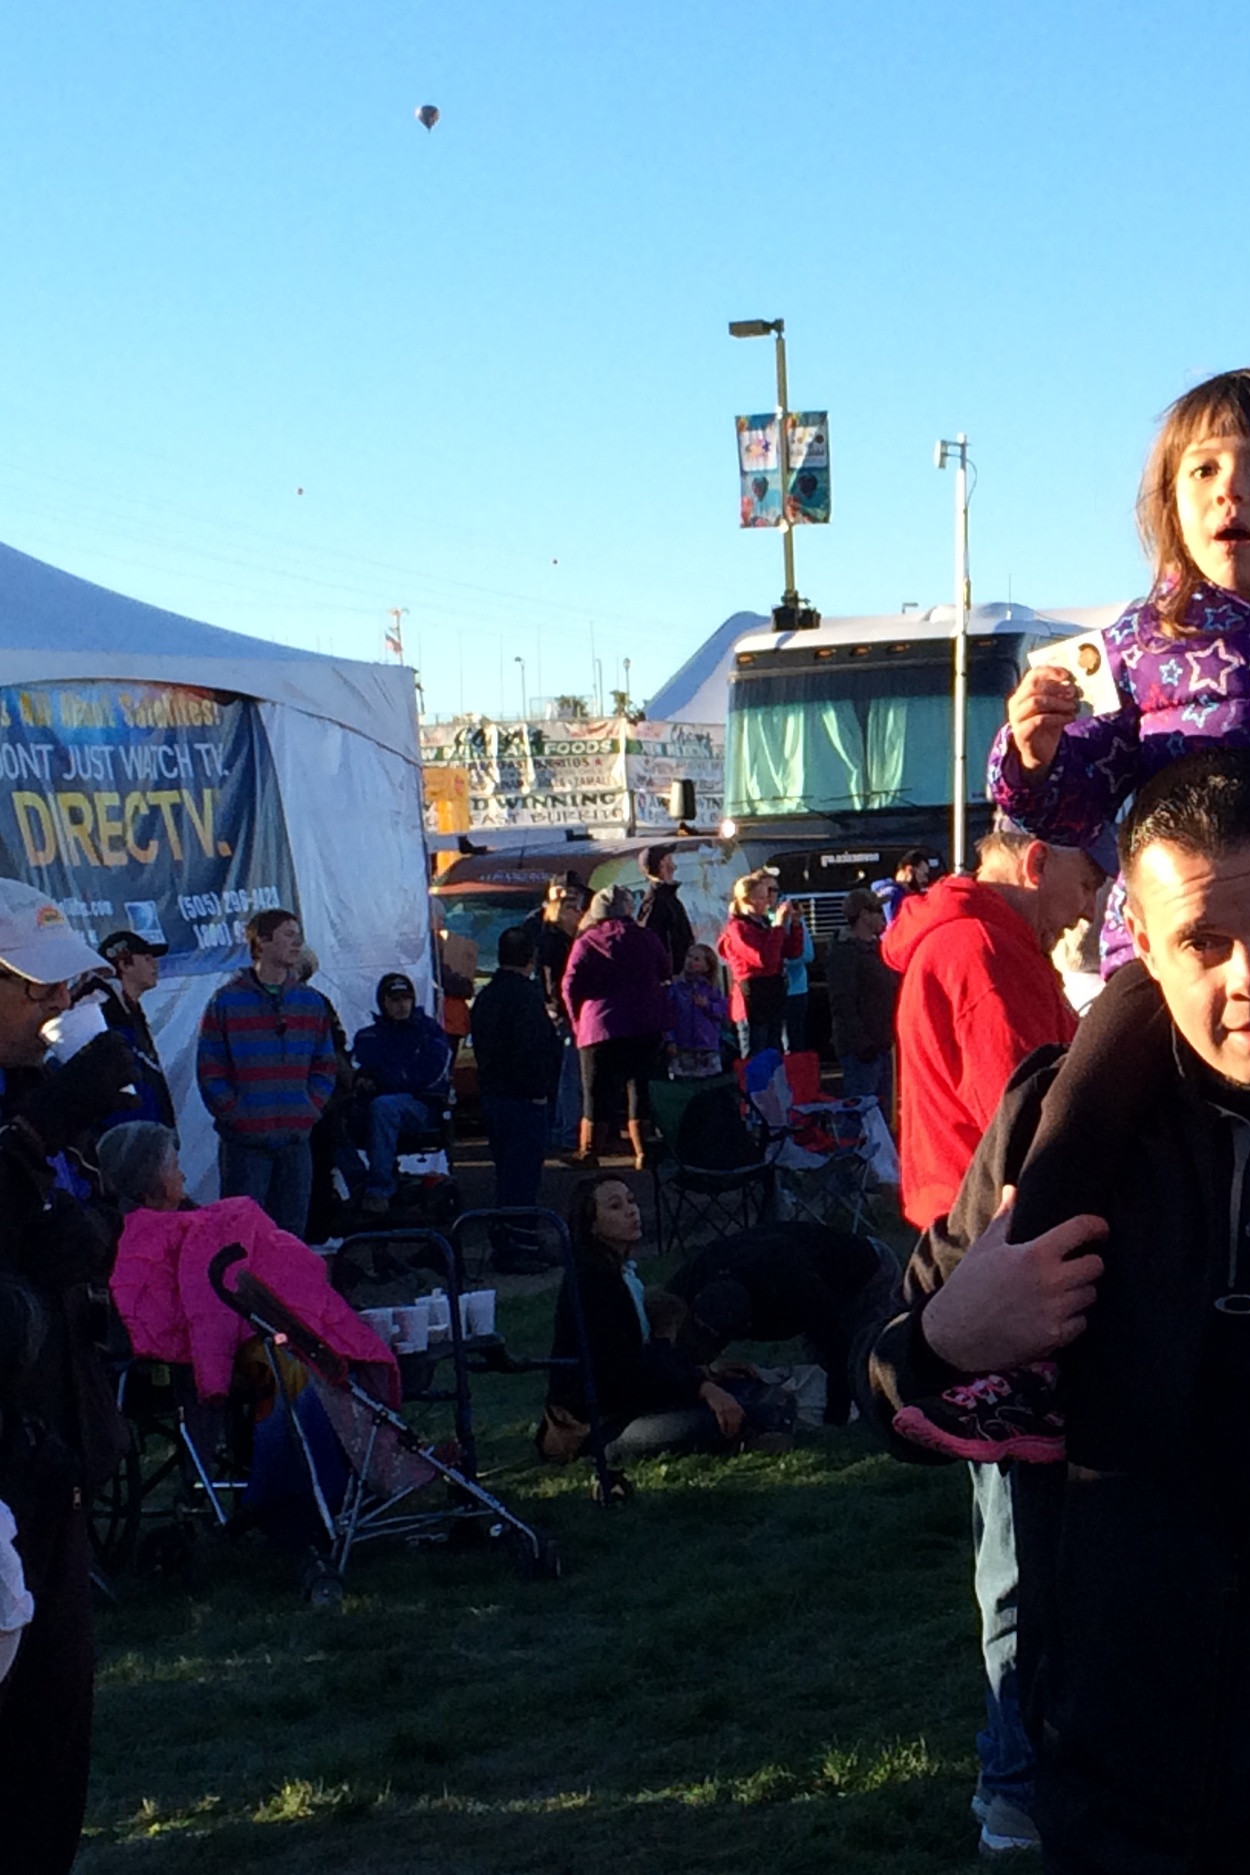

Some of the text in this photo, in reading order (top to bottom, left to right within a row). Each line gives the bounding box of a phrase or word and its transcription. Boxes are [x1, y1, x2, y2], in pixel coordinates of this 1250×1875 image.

[0, 742, 230, 780] ONT JUST WATCH TV.
[544, 740, 612, 755] FOODS
[500, 792, 616, 809] WINNING
[12, 788, 232, 867] DIRECTV.
[177, 891, 222, 922] (505)
